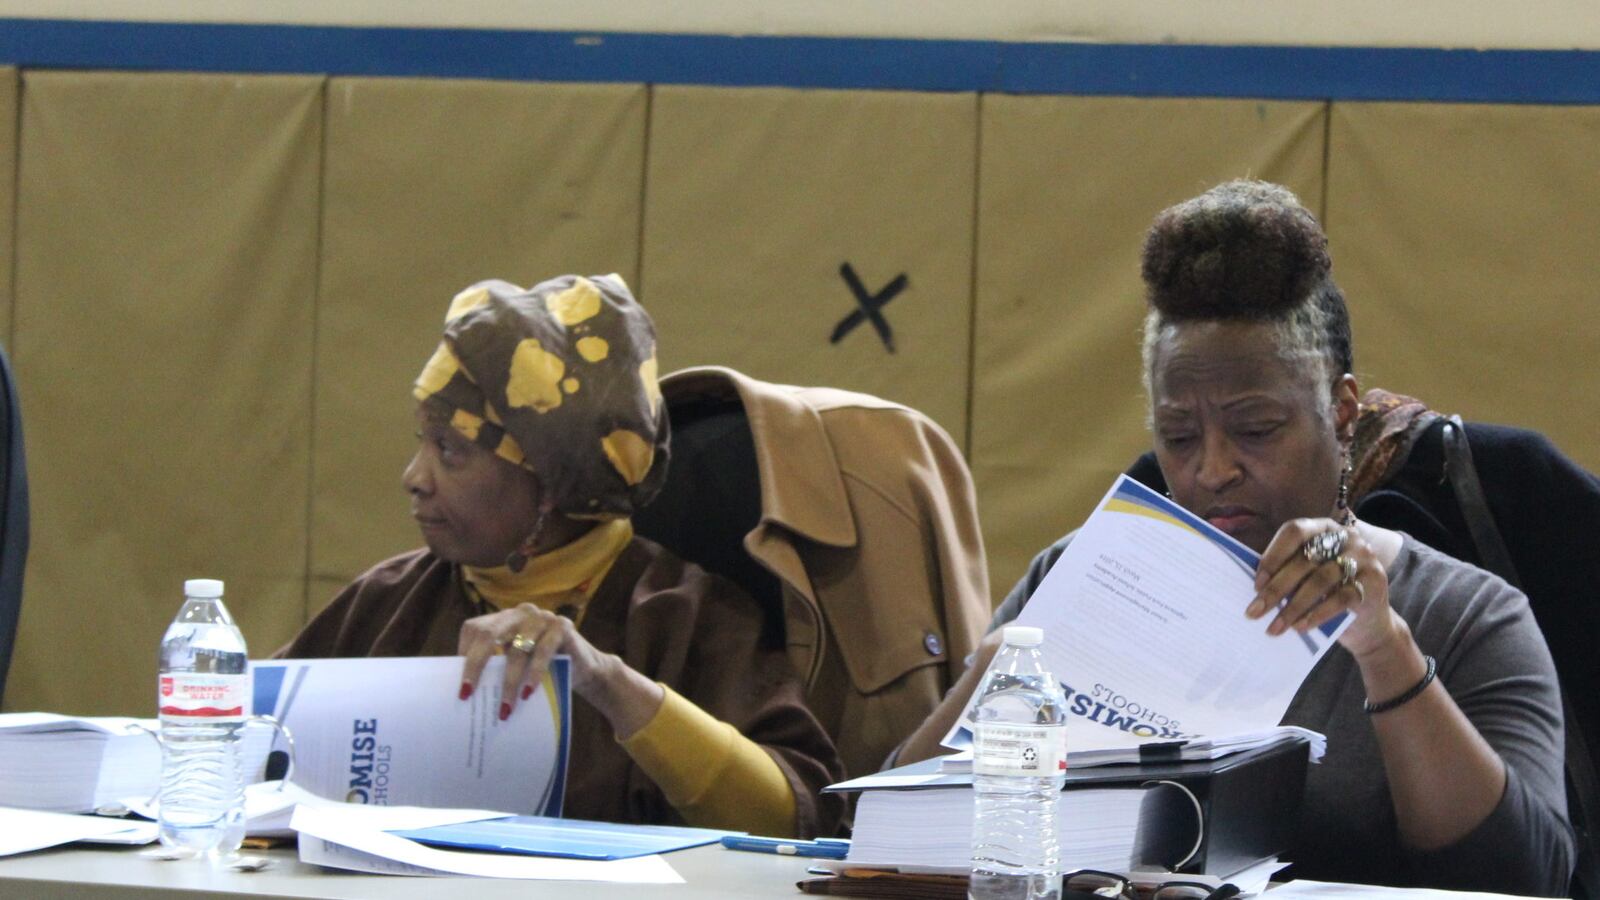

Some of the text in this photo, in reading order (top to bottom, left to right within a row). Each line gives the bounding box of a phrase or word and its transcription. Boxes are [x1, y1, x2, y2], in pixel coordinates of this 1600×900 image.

[1091, 682, 1182, 730] SCHOOLS
[346, 718, 378, 804] OMISE
[374, 745, 393, 806] CHOOLS
